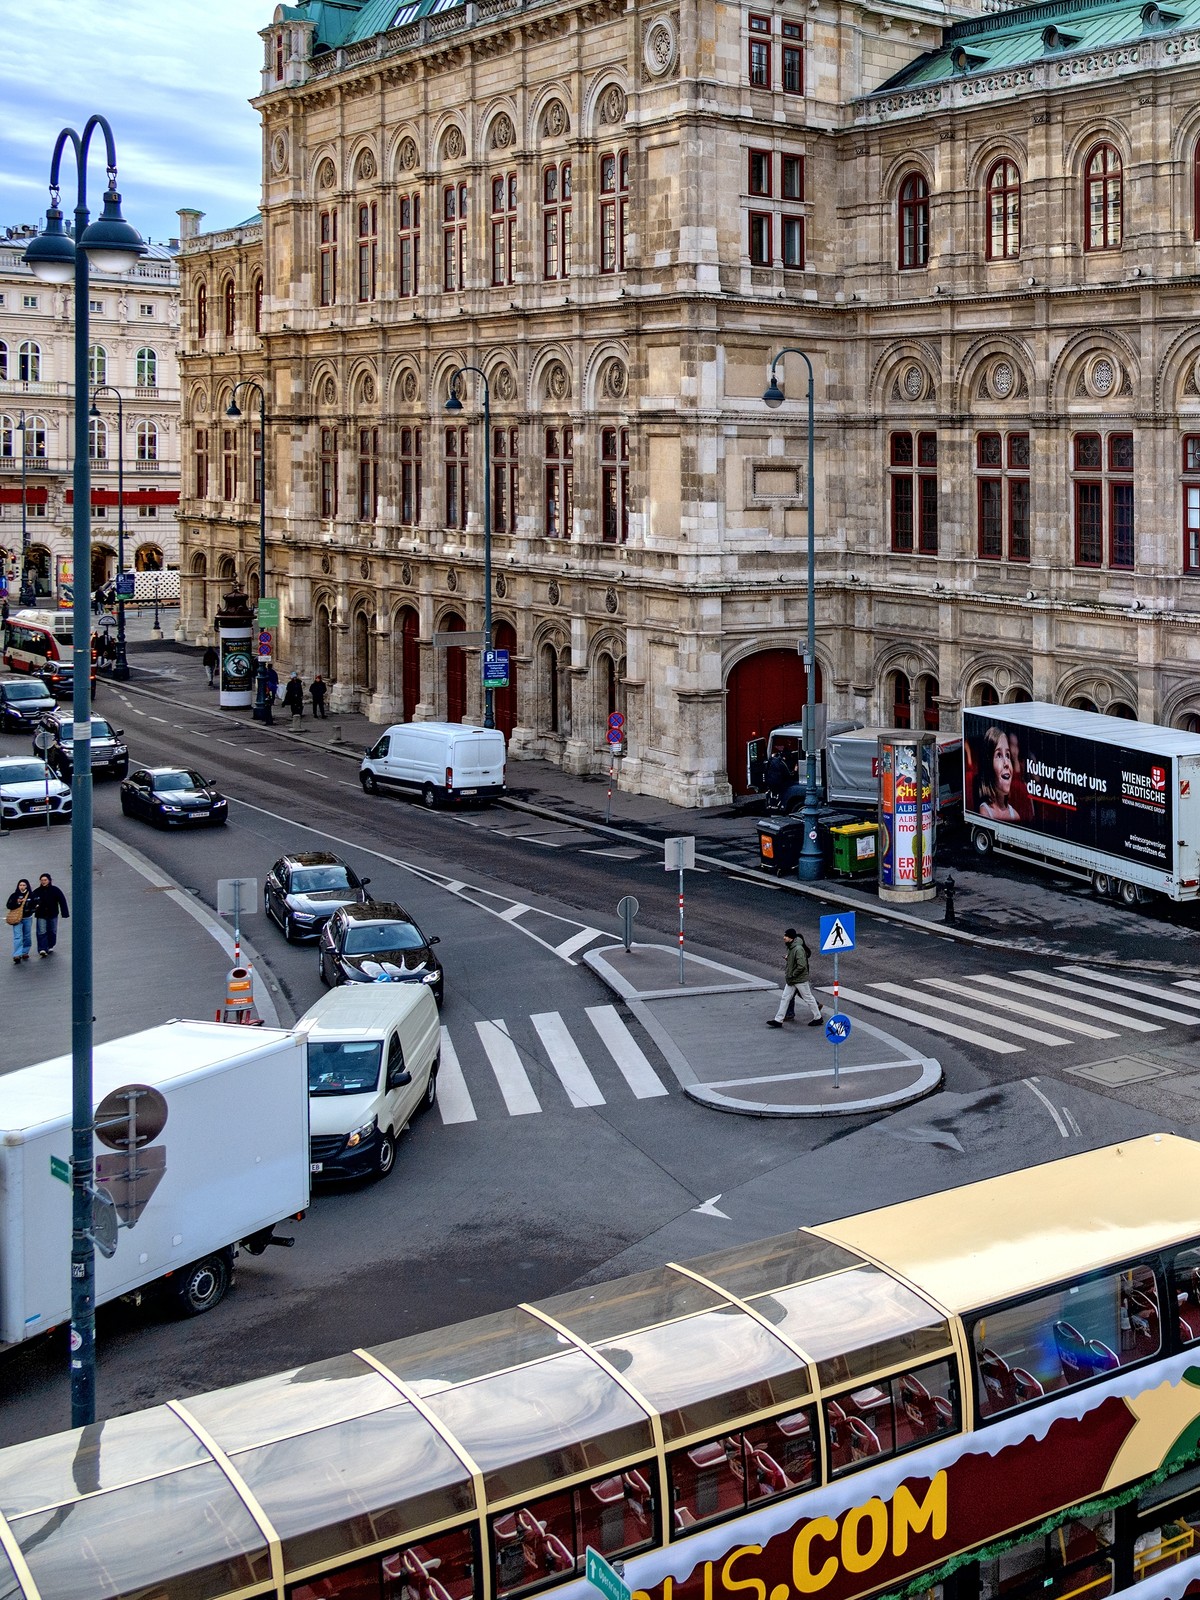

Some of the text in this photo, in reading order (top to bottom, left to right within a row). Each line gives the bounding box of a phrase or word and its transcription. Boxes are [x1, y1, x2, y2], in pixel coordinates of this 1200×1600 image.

[1026, 758, 1107, 793] Kultur öffnet uns
[1121, 770, 1151, 788] WIENER
[1026, 779, 1077, 807] die Augen.
[1121, 783, 1166, 804] STÄDTISCHE
[1122, 798, 1135, 806] VIENNA
[1134, 800, 1154, 812] INSURANCE
[1124, 840, 1132, 849] Wir
[1165, 875, 1173, 883] 34
